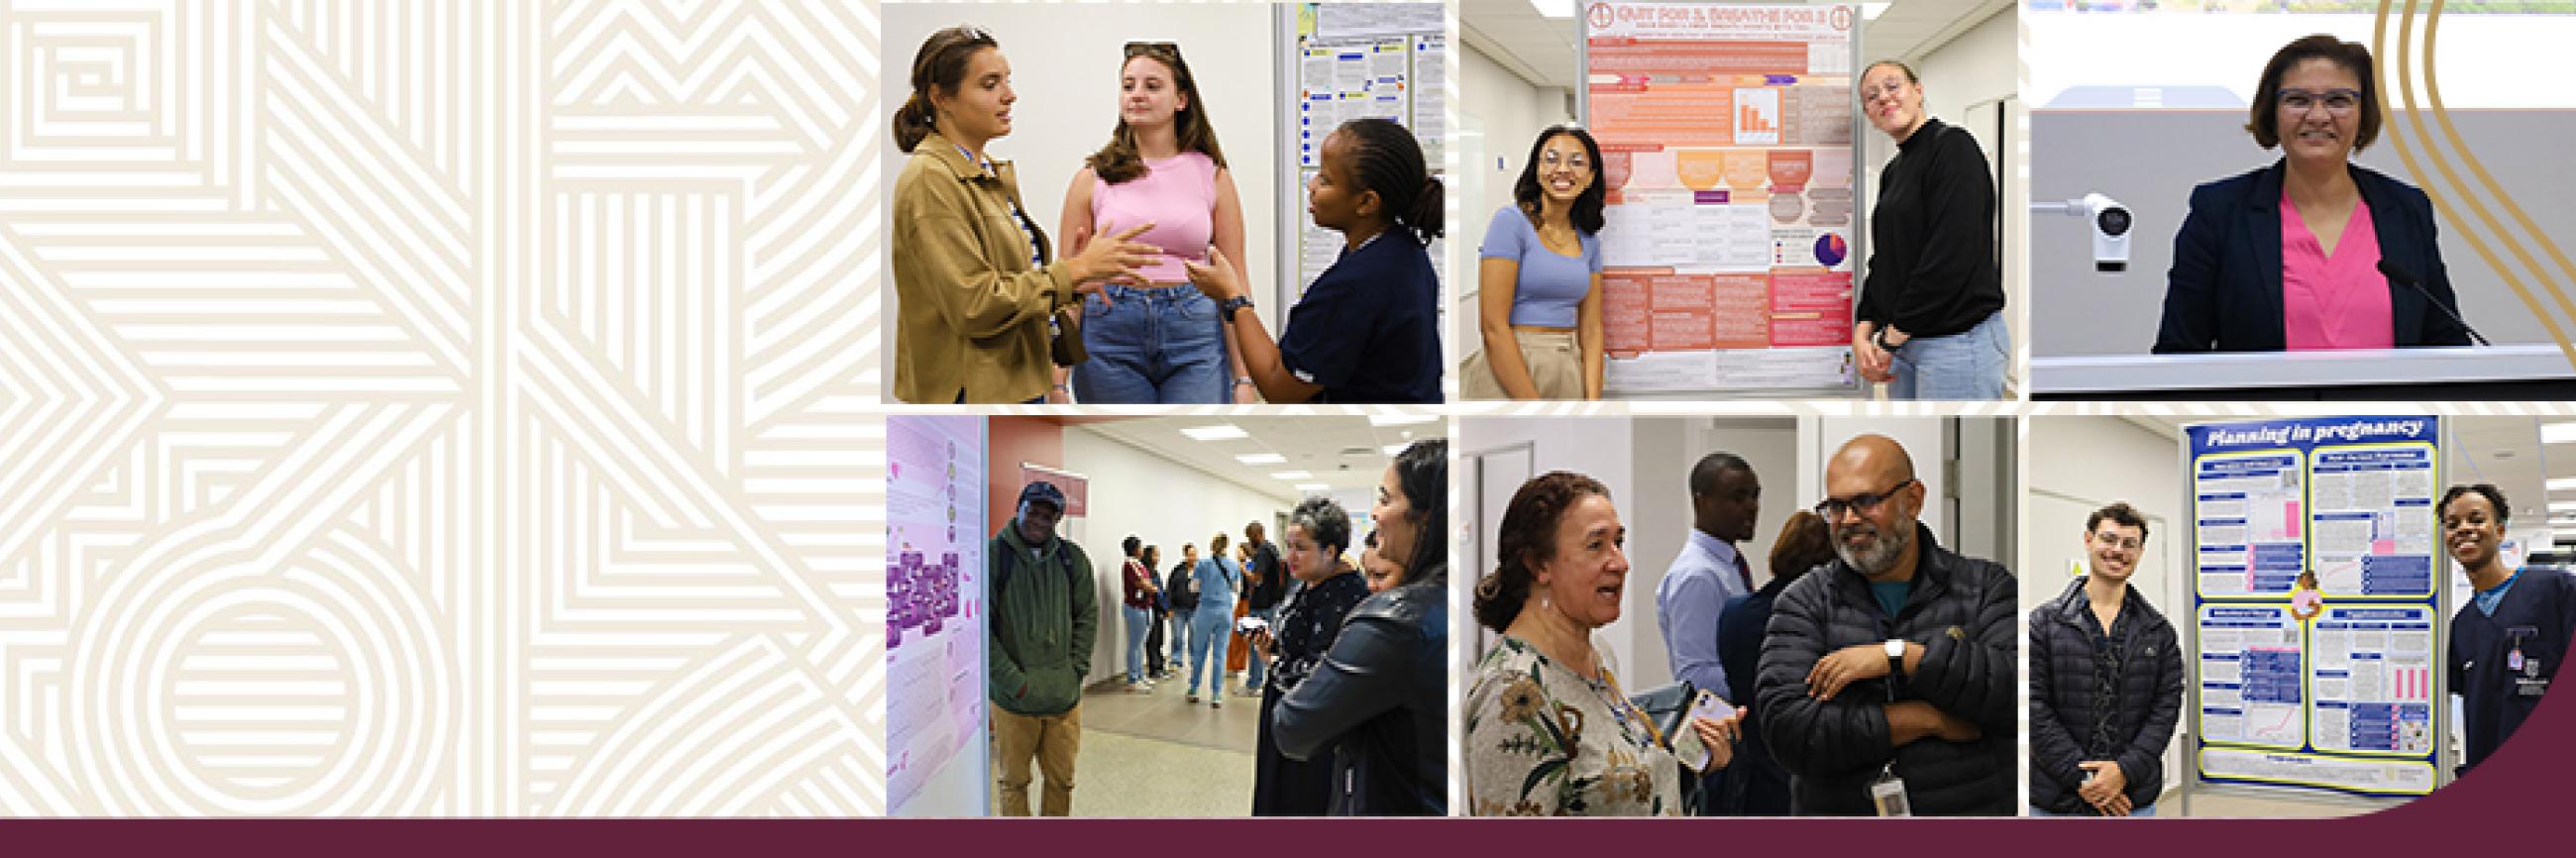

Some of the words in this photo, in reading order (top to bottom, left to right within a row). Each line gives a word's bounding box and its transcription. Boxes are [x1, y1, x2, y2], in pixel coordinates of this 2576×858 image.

[2207, 424, 2292, 447] Planning
[2292, 423, 2311, 440] in
[2313, 419, 2423, 443] pregnancy
